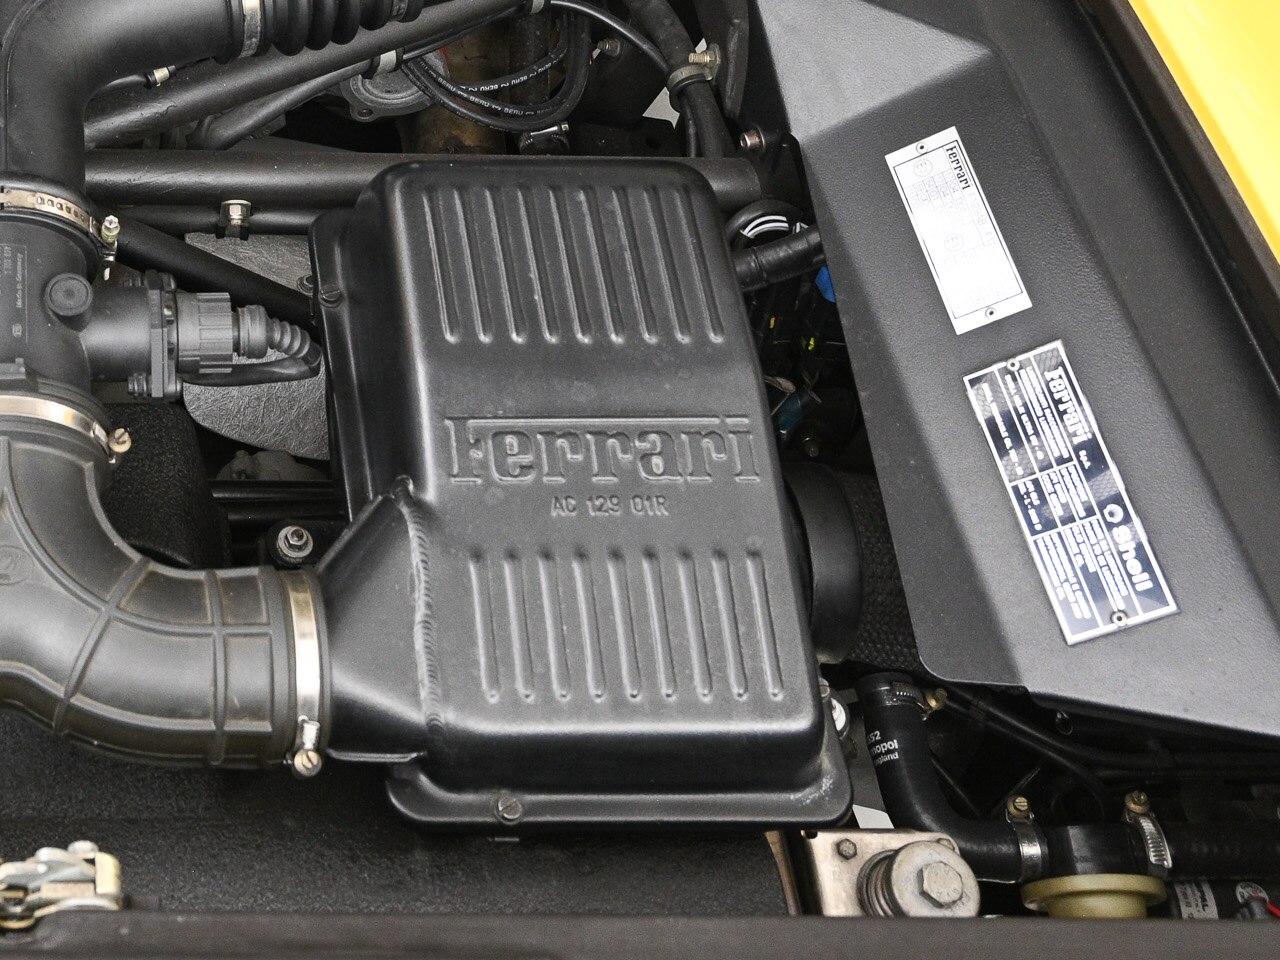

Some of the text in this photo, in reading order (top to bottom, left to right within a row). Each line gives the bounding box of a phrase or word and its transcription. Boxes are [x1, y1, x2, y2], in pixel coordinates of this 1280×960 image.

[944, 144, 974, 191] Ferrari
[1043, 366, 1092, 445] Ferrari
[444, 414, 762, 485] Ferrari
[550, 495, 578, 516] AC
[585, 495, 620, 516] 129
[1111, 524, 1153, 592] Shell
